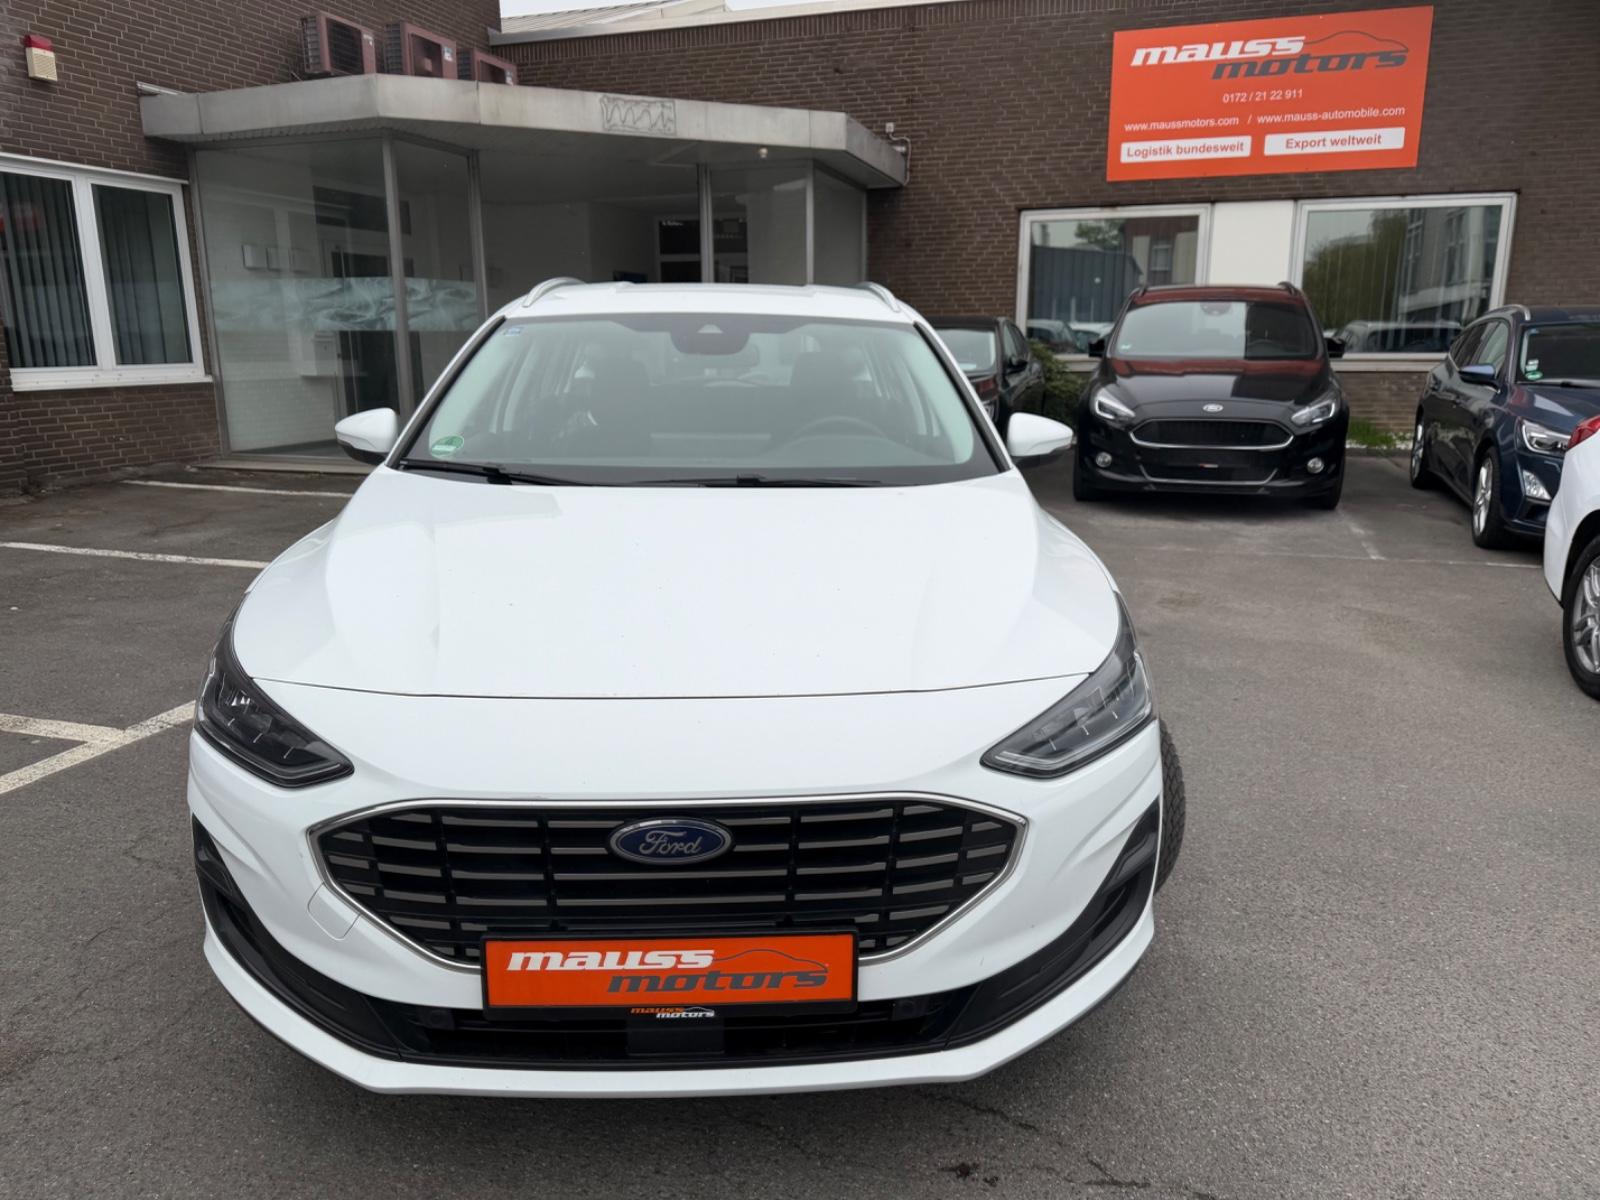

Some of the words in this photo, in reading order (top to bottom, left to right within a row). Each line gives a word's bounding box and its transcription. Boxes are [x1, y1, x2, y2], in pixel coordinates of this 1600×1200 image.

[1130, 36, 1306, 67] mauss
[1210, 50, 1408, 80] motors
[1222, 92, 1247, 104] 0172
[1255, 91, 1267, 101] 21
[1269, 90, 1283, 100] 22
[1285, 88, 1303, 99] 911
[1123, 116, 1239, 132] www.maussmotors.com
[1257, 106, 1406, 124] www.mauss-automobile.com
[1127, 145, 1173, 159] Logistik
[1176, 141, 1245, 156] bundesweit
[1285, 138, 1327, 151] Export
[1330, 133, 1383, 147] weltweit
[638, 829, 704, 856] Ford
[506, 949, 714, 971] mauss
[607, 970, 829, 993] motors
